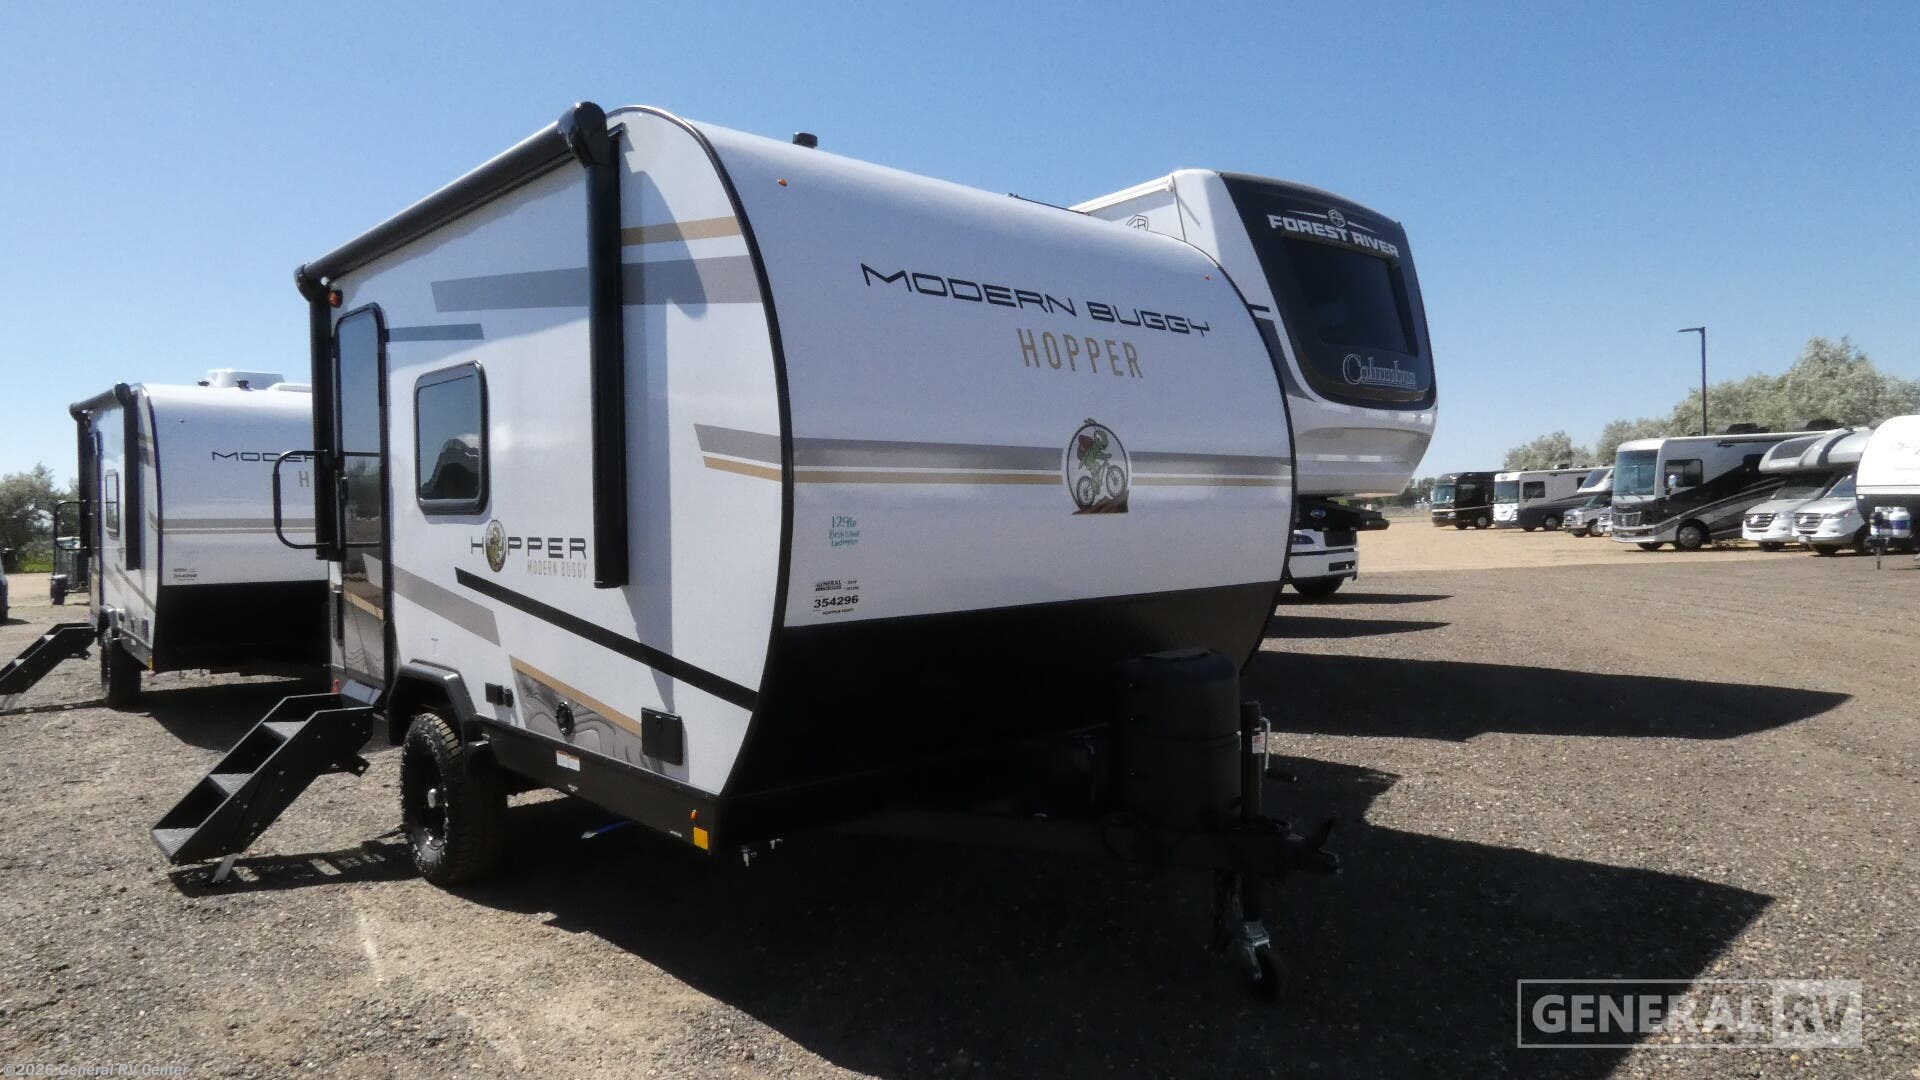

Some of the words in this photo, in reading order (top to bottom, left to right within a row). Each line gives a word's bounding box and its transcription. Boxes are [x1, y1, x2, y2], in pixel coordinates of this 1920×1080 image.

[1266, 214, 1348, 241] FOREST
[1350, 231, 1400, 258] RIVER
[860, 263, 1077, 317] MODERN
[1086, 301, 1211, 337] BUGGY
[1016, 328, 1144, 380] HOPPER
[527, 559, 558, 577] MODERN
[561, 560, 587, 578] BUGGY
[813, 595, 859, 608] 354296
